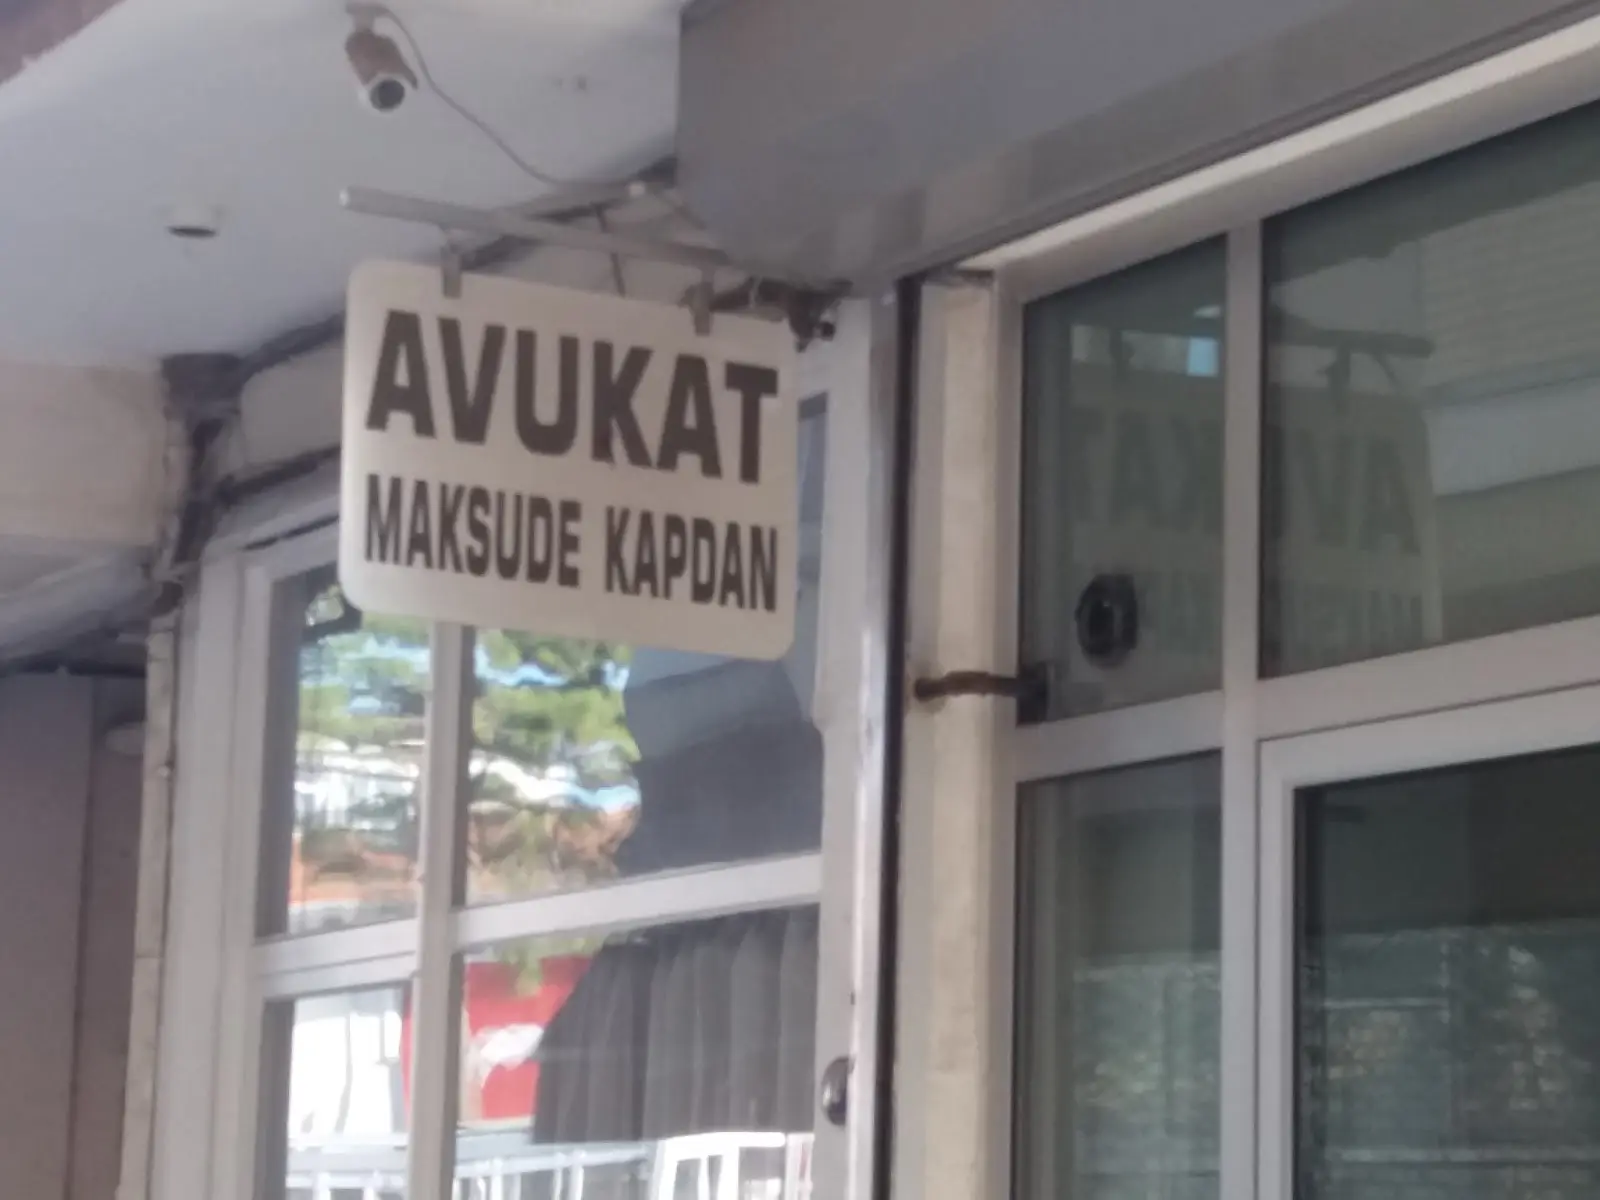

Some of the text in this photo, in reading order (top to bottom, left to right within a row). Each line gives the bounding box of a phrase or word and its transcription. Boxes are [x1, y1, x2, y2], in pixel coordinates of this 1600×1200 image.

[366, 309, 778, 484] AVUKAT
[365, 474, 777, 612] MAKSUDE KAPDAN
